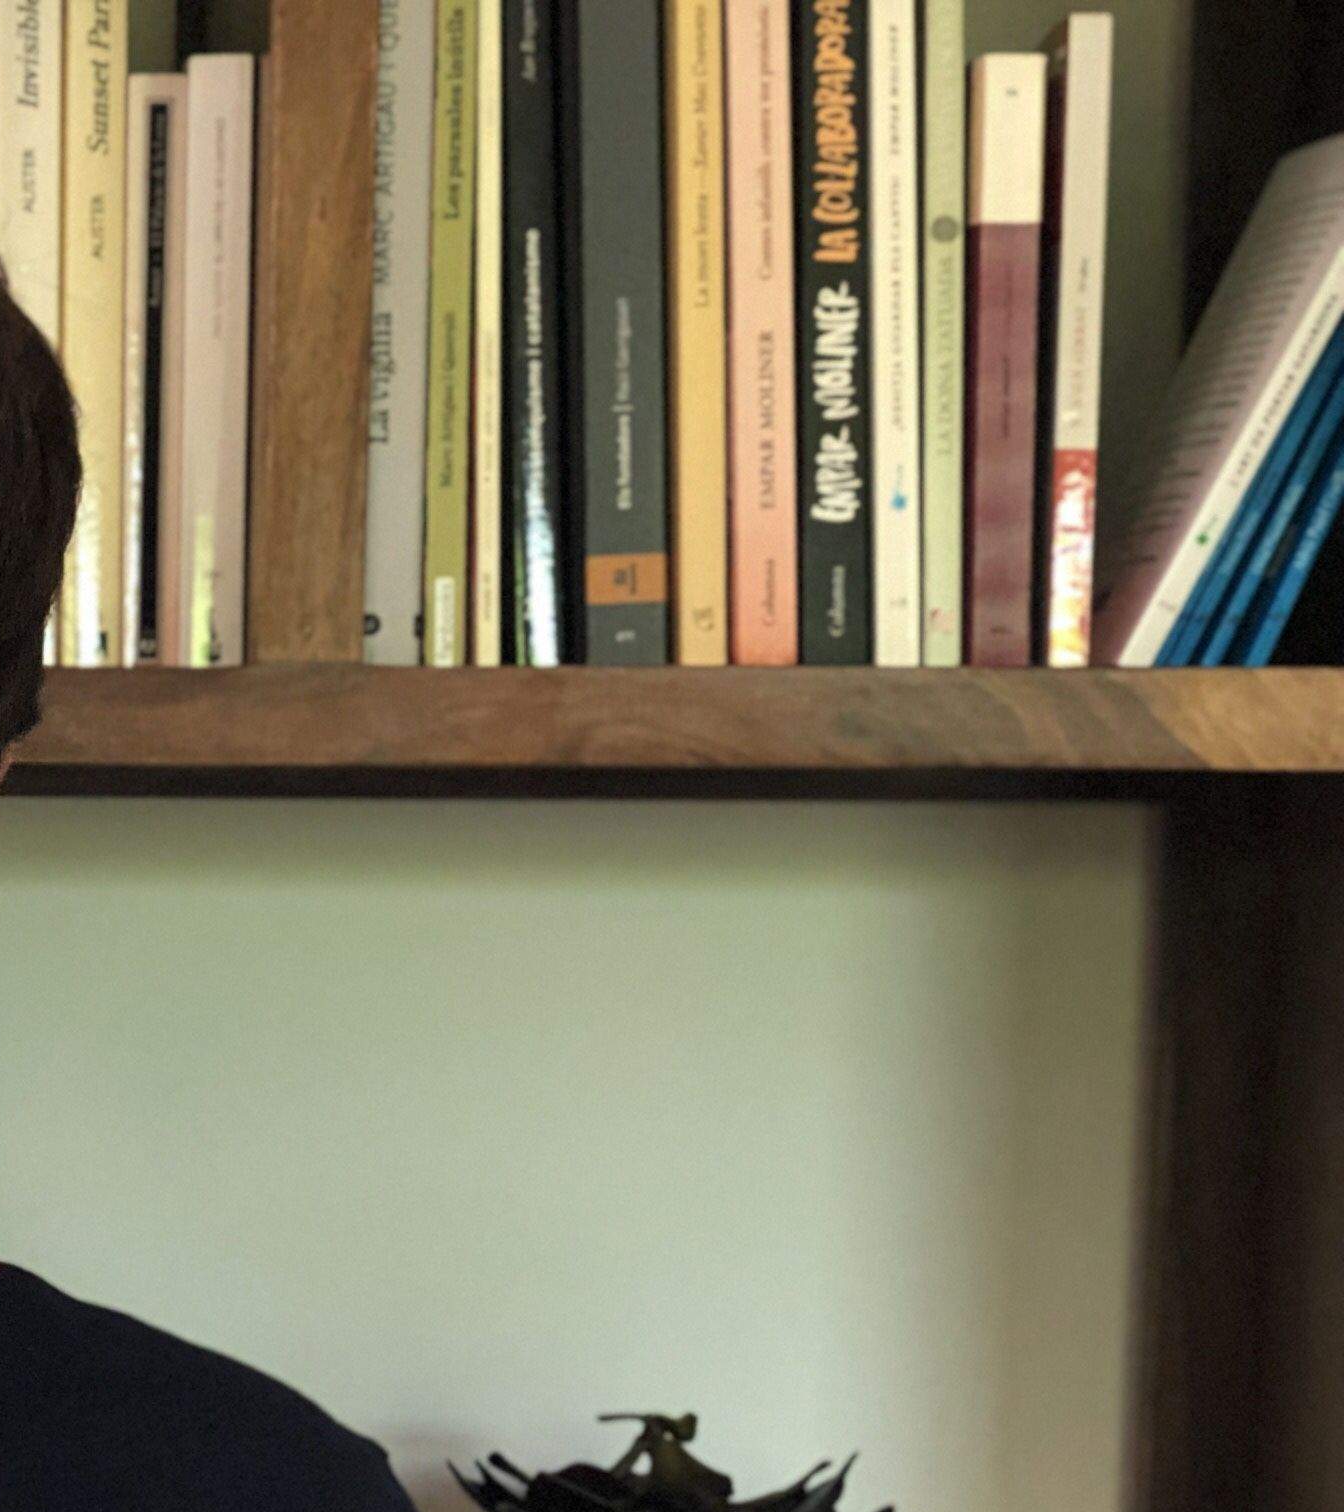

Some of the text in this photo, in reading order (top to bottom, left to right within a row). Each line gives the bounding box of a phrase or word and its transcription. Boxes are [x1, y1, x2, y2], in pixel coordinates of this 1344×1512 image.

[88, 0, 112, 51] Par
[86, 60, 110, 155] Sunset
[813, 228, 859, 263] LA
[813, 280, 860, 420] MOLINER
